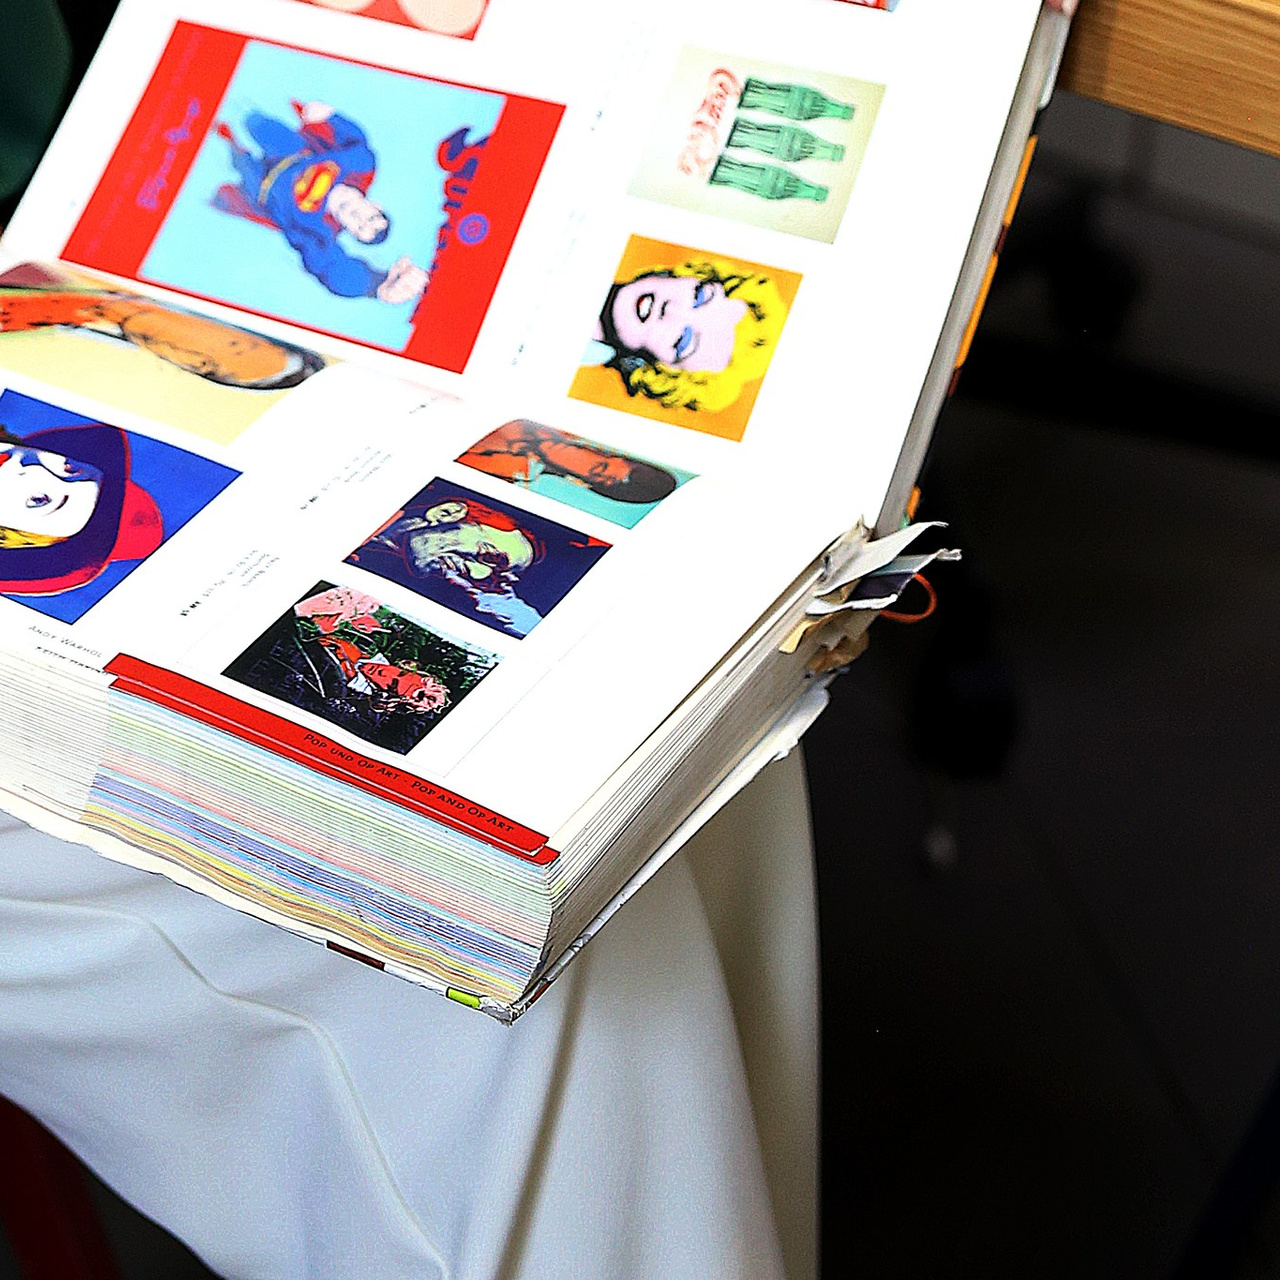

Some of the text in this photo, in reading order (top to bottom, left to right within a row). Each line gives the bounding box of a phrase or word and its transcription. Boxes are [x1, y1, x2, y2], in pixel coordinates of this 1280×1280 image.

[60, 637, 103, 658] WARHOL
[303, 733, 515, 833] POP UND OP ART POP AND OP ART
